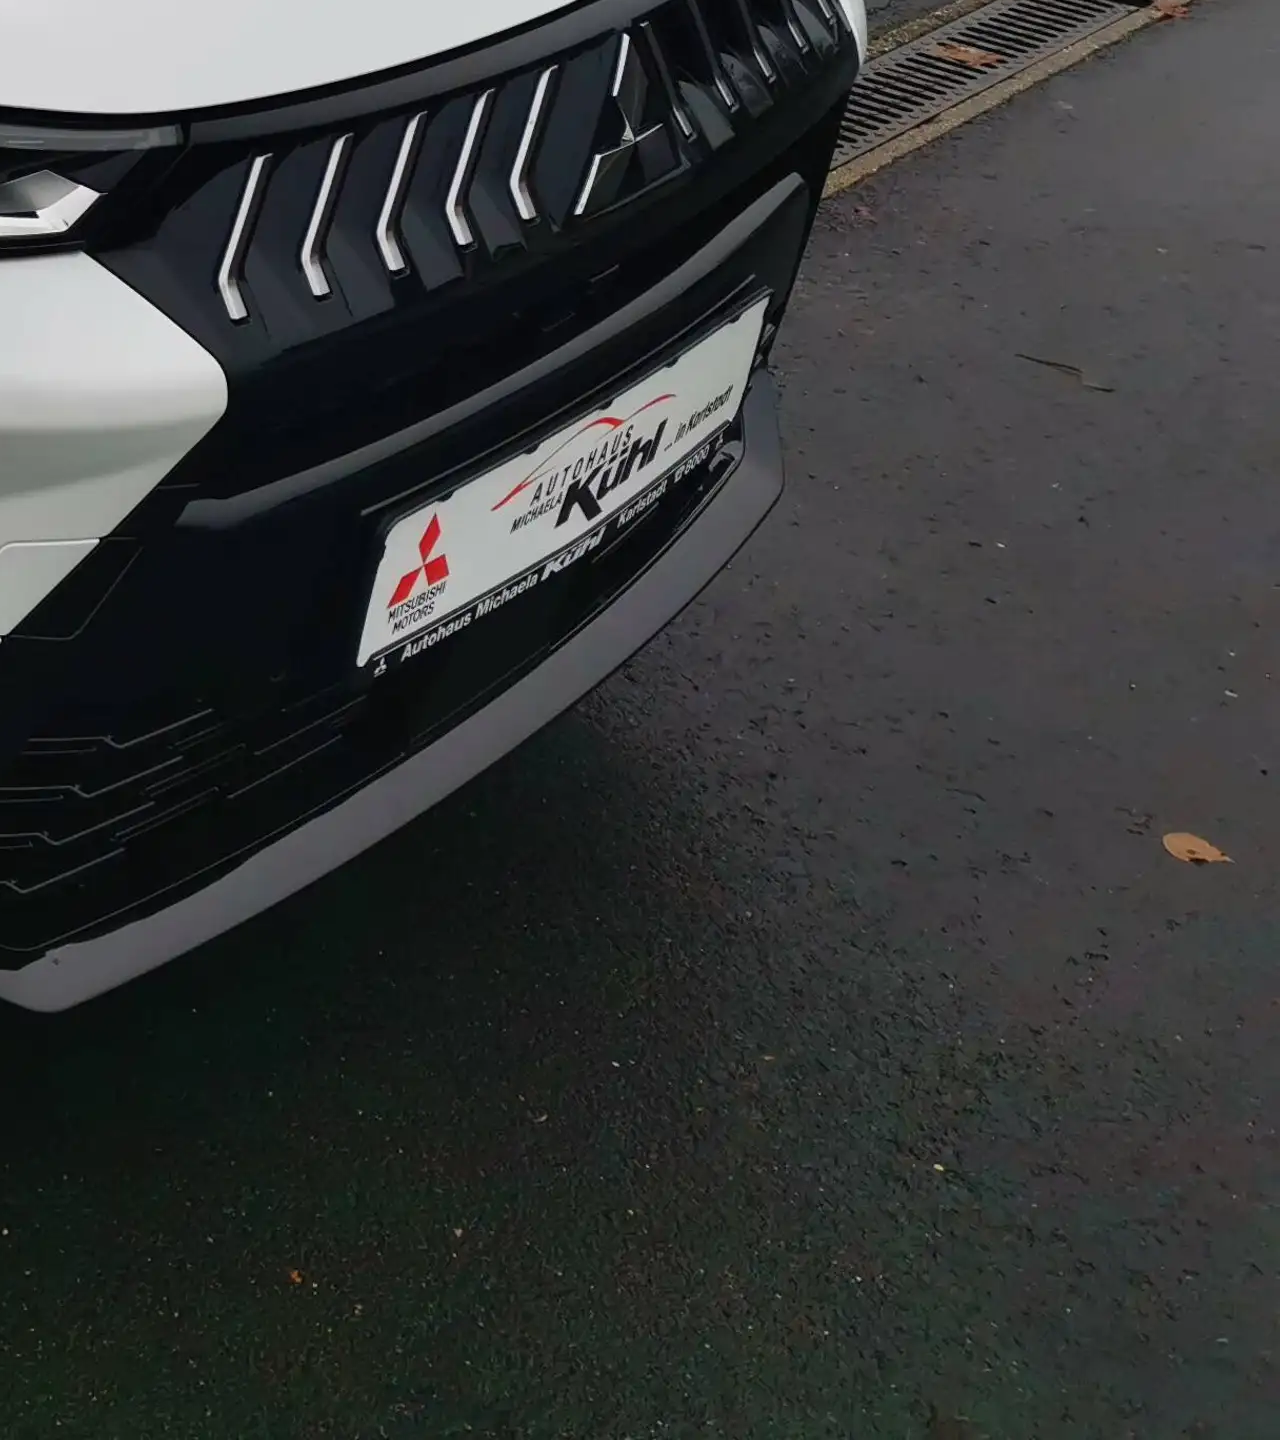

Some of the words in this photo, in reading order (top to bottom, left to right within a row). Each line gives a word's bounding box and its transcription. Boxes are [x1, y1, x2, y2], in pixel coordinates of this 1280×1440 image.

[530, 423, 634, 506] AUTOHAUS
[554, 417, 669, 529] Kühl
[510, 491, 564, 535] MICHAELA
[388, 580, 448, 623] MITSUBISHI
[401, 611, 472, 663] Autohaus
[474, 571, 539, 620] Michaela
[617, 479, 668, 529] Karlstadt
[392, 602, 435, 635] MOTORS
